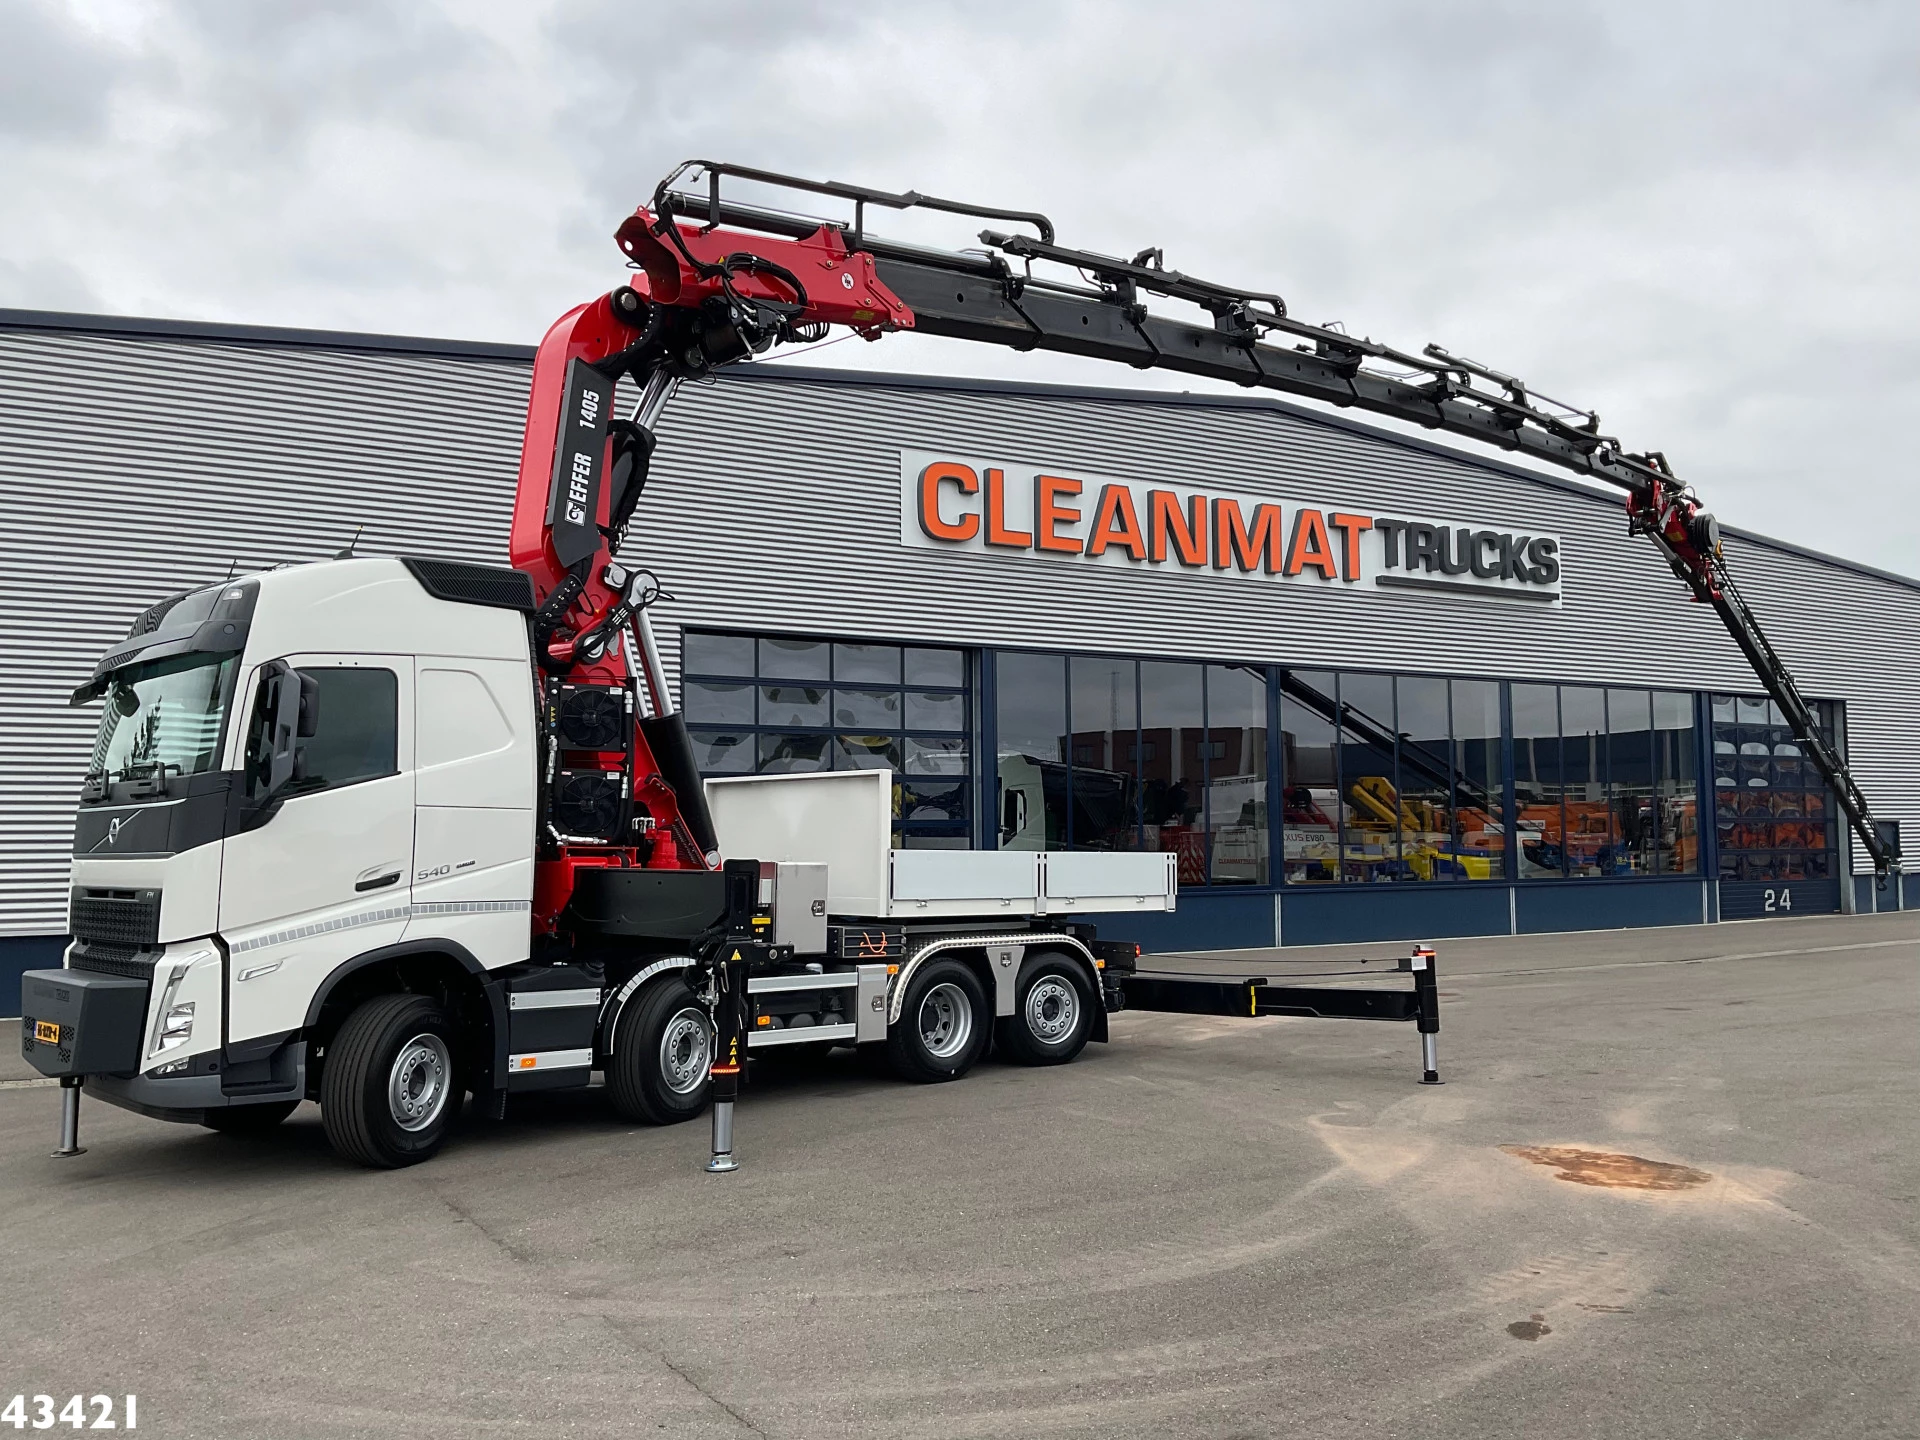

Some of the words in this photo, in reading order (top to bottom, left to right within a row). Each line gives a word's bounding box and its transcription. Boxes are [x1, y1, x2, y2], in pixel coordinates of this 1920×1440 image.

[580, 389, 600, 429] 1405
[569, 452, 592, 503] EFFER
[917, 461, 1372, 582] CLEANMAT
[1375, 517, 1560, 584] TRUCKS
[1284, 833, 1304, 842] XUS
[1305, 834, 1325, 842] EV80
[417, 864, 451, 880] 540
[1764, 888, 1792, 912] 24
